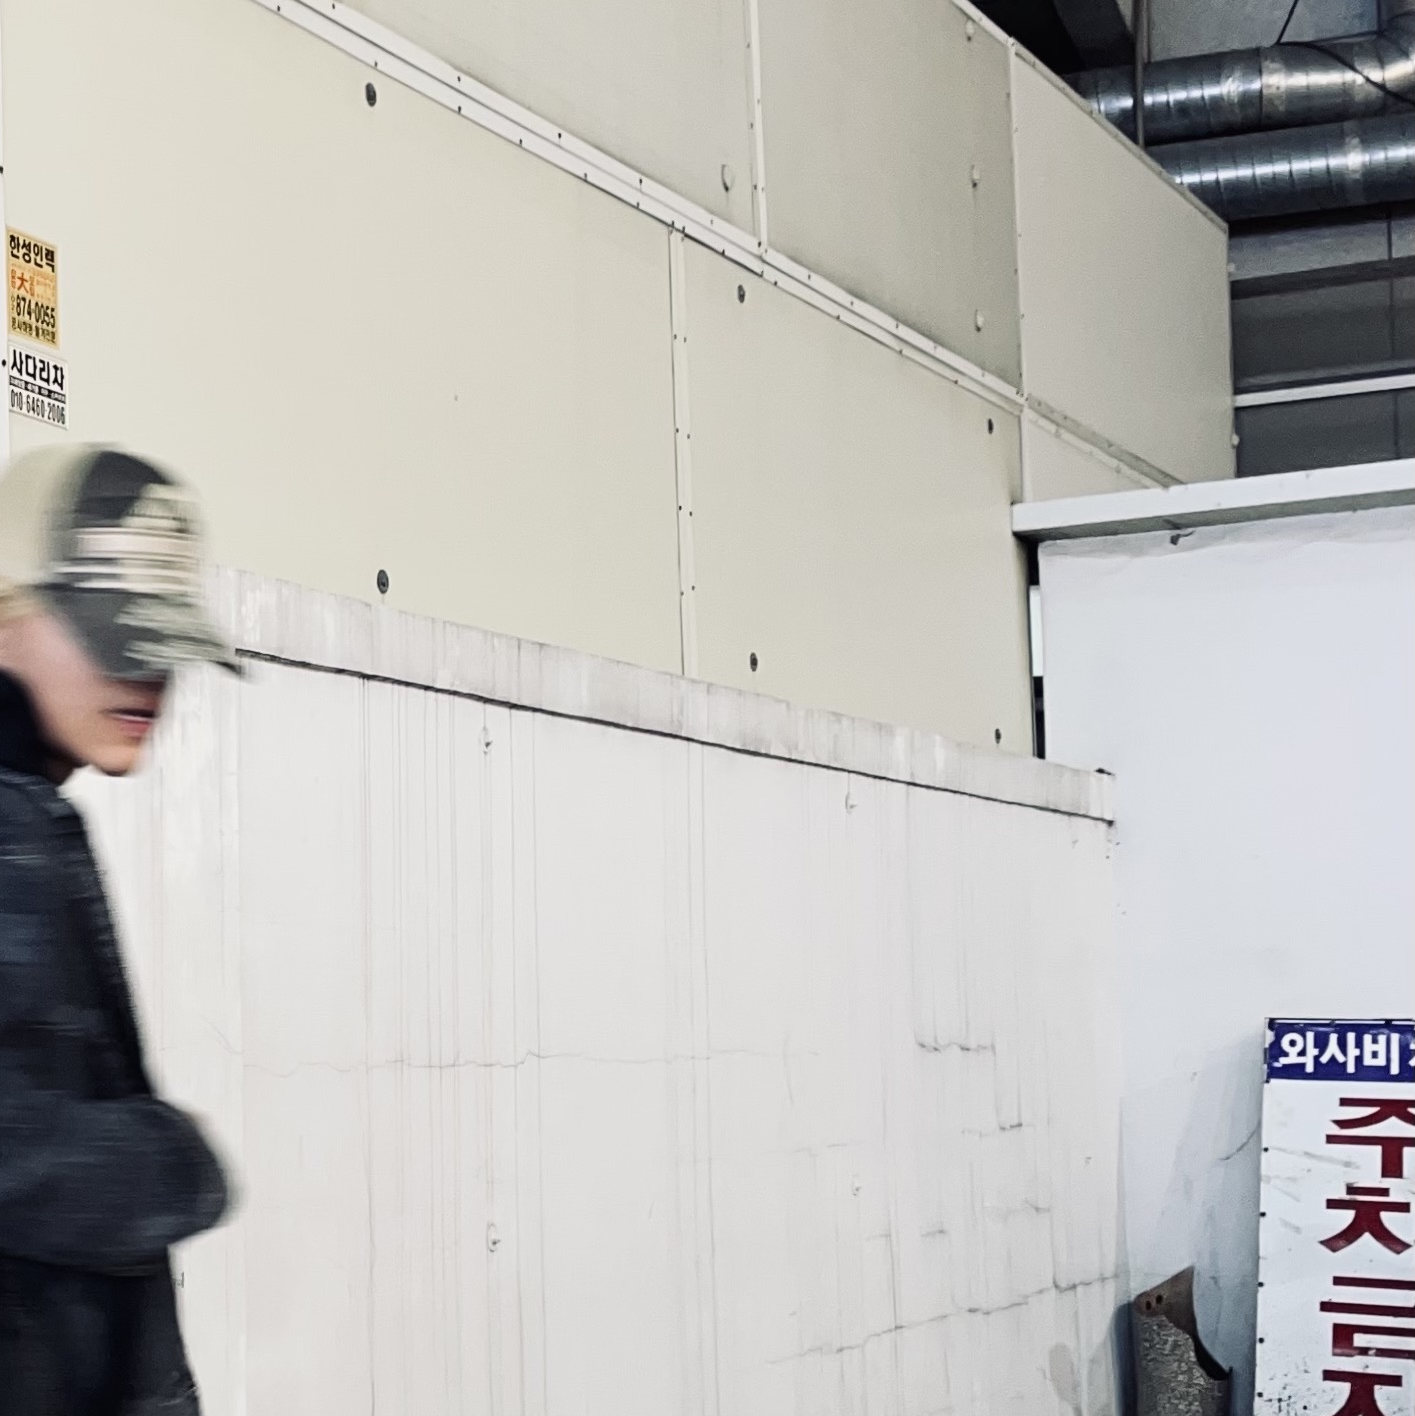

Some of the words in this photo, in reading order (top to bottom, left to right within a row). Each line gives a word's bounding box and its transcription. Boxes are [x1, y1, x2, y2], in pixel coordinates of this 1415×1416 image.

[9, 234, 55, 273] 한성인력
[11, 349, 64, 391] 사다리차
[1278, 1031, 1415, 1075] 와사비
